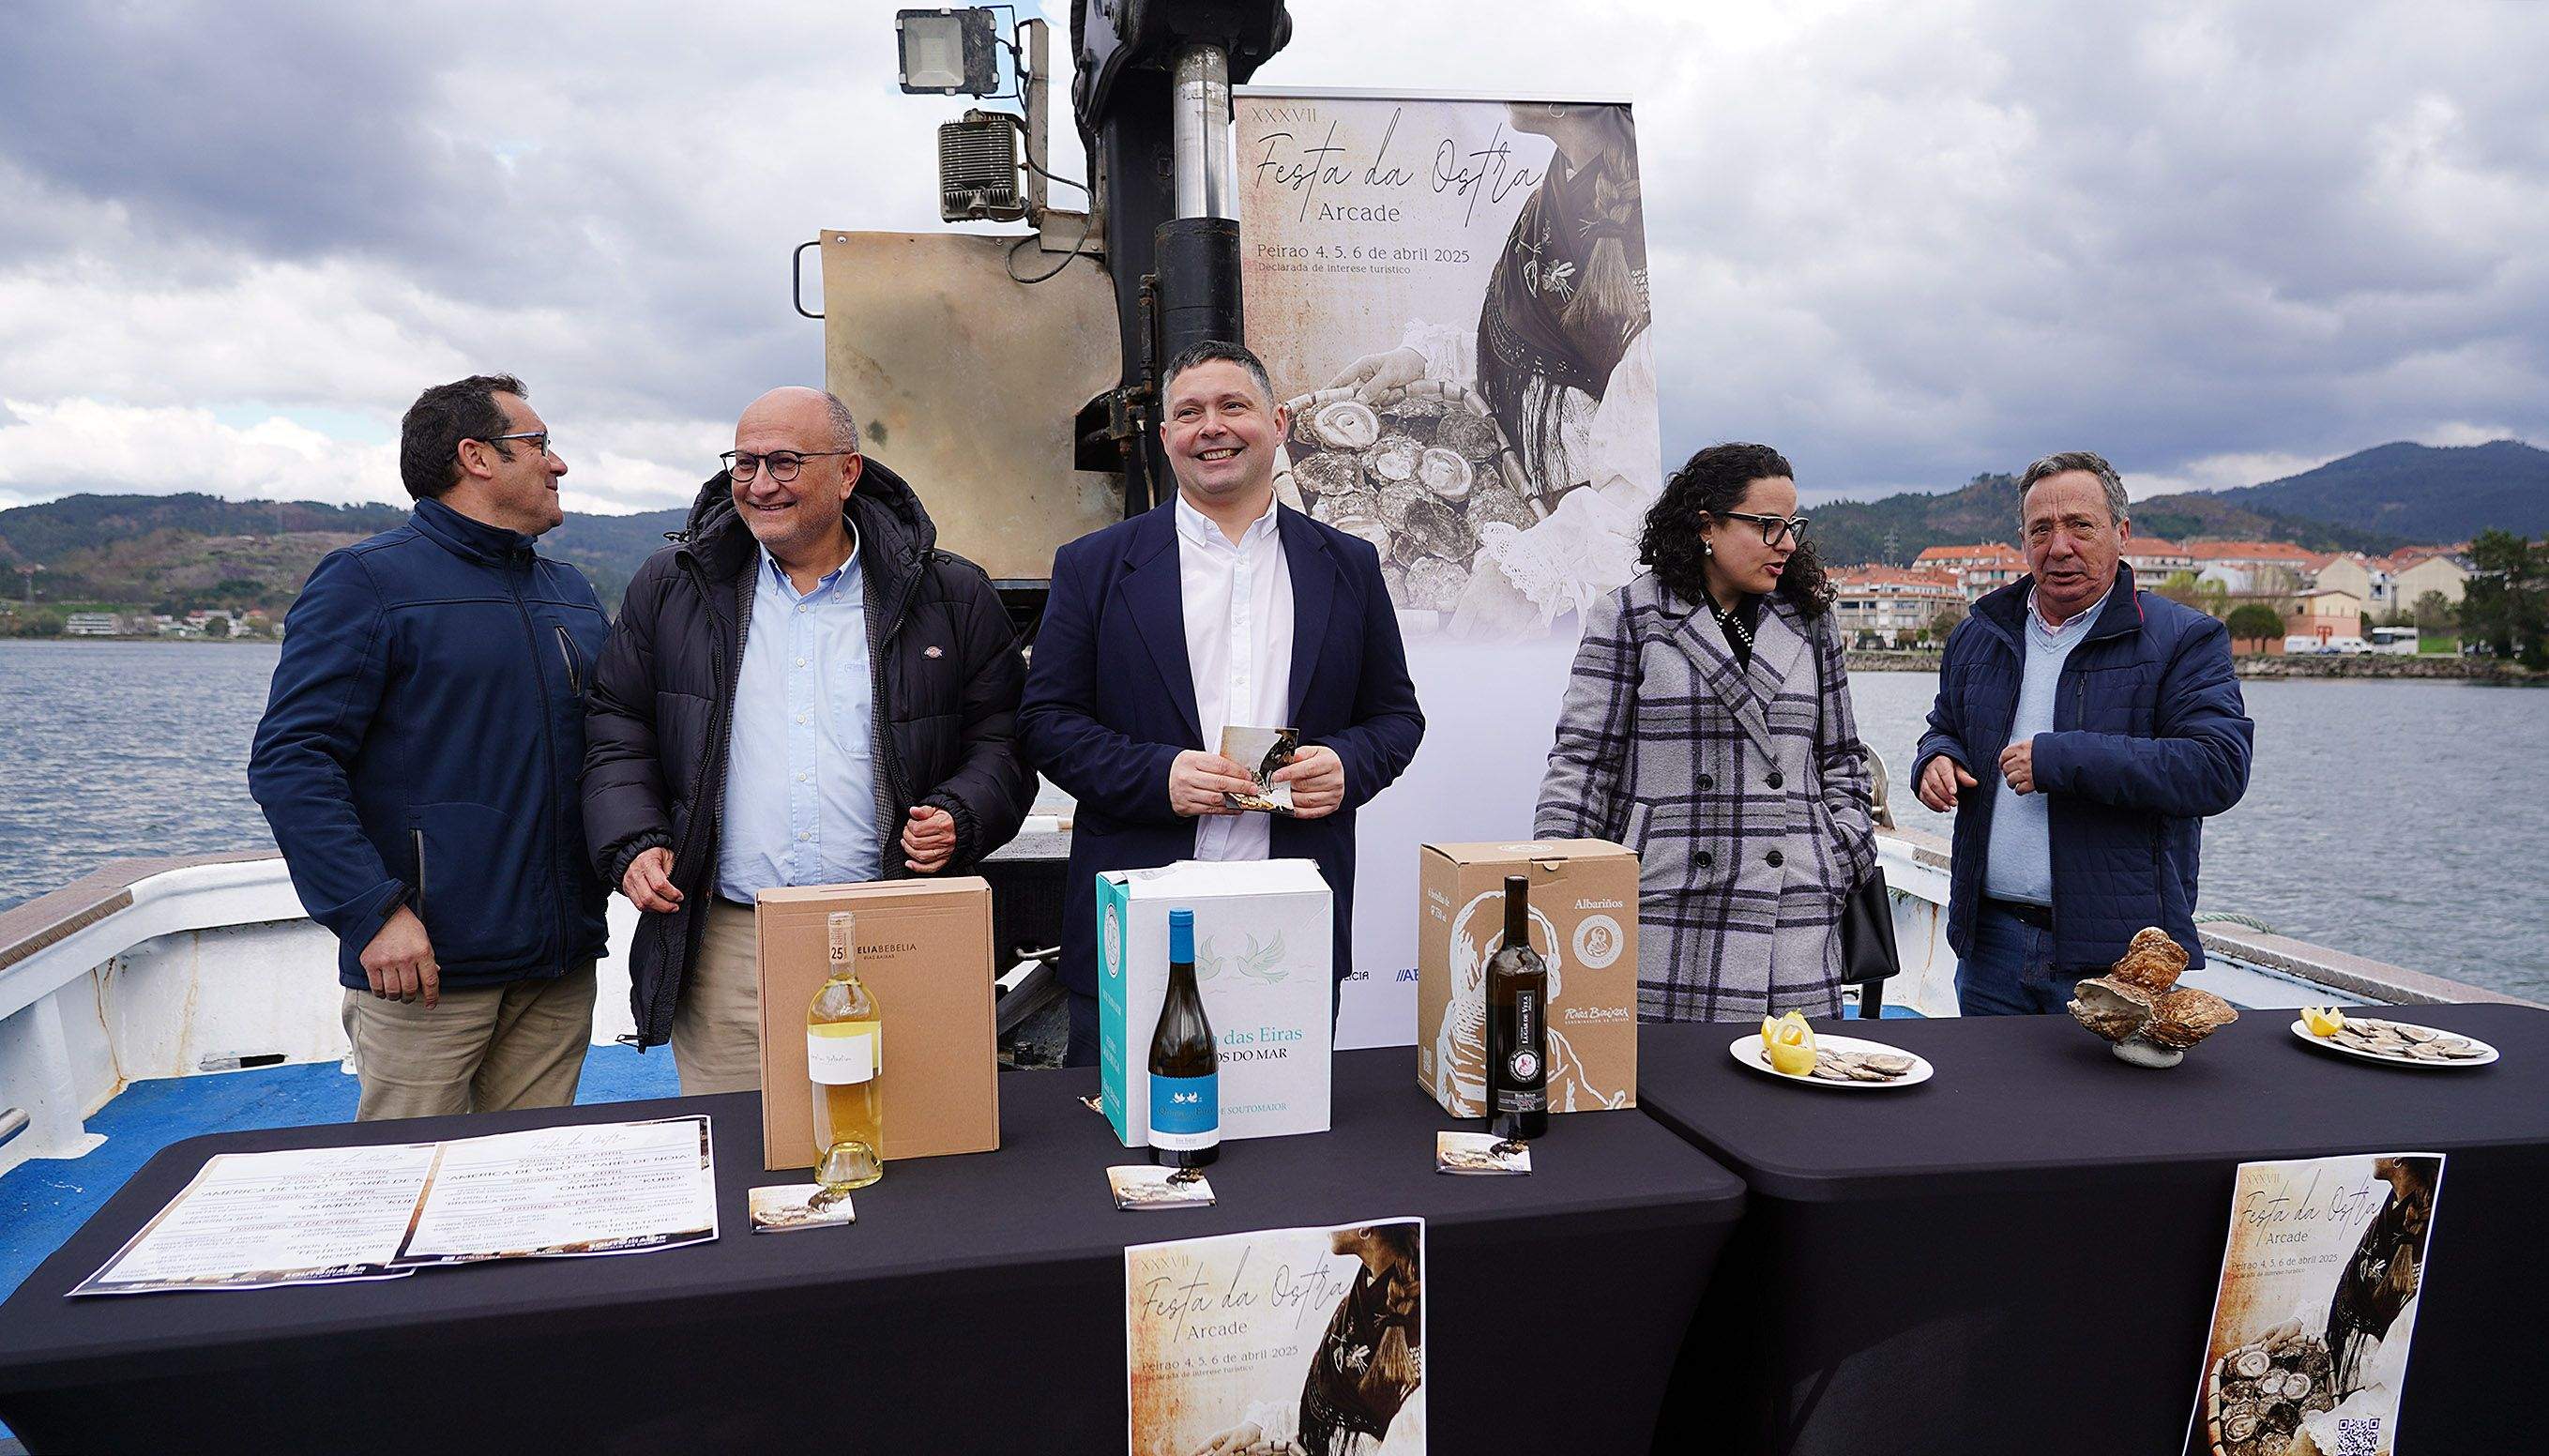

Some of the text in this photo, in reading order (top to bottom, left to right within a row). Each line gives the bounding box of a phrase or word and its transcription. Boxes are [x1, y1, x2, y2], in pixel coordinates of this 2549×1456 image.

[1251, 107, 1316, 124] XXXVII
[1256, 107, 1542, 228] Festa da Ostra
[1318, 203, 1401, 222] Arcade
[1257, 244, 1309, 258] Peirao
[1353, 246, 1361, 259] 6
[1368, 246, 1387, 260] de
[1393, 246, 1428, 261] abril
[1434, 249, 1470, 263] 2025
[1258, 262, 1309, 271] Declarada
[1312, 263, 1324, 272] de
[1574, 898, 1624, 910] Albariños
[831, 947, 843, 960] 25
[1224, 1029, 1254, 1045] das
[1260, 1026, 1302, 1042] Eiras
[1233, 1050, 1253, 1062] DO
[1256, 1048, 1287, 1060] MAR
[1227, 1102, 1288, 1115] SOUTOMAIOR
[2238, 1168, 2381, 1247] Festa da Ostra
[2266, 1231, 2309, 1245] Arcade
[2278, 1258, 2284, 1266] 6
[2285, 1257, 2295, 1266] de
[2298, 1255, 2316, 1265] abril
[2318, 1253, 2338, 1264] 2025
[1142, 1245, 1351, 1343] Festa da Ostra
[1187, 1321, 1248, 1341] Arcade
[1142, 1359, 1179, 1372] Peirao
[1211, 1355, 1218, 1365] 6
[1222, 1354, 1237, 1364] de
[1241, 1350, 1267, 1361] abril
[1272, 1345, 1298, 1358] 2025
